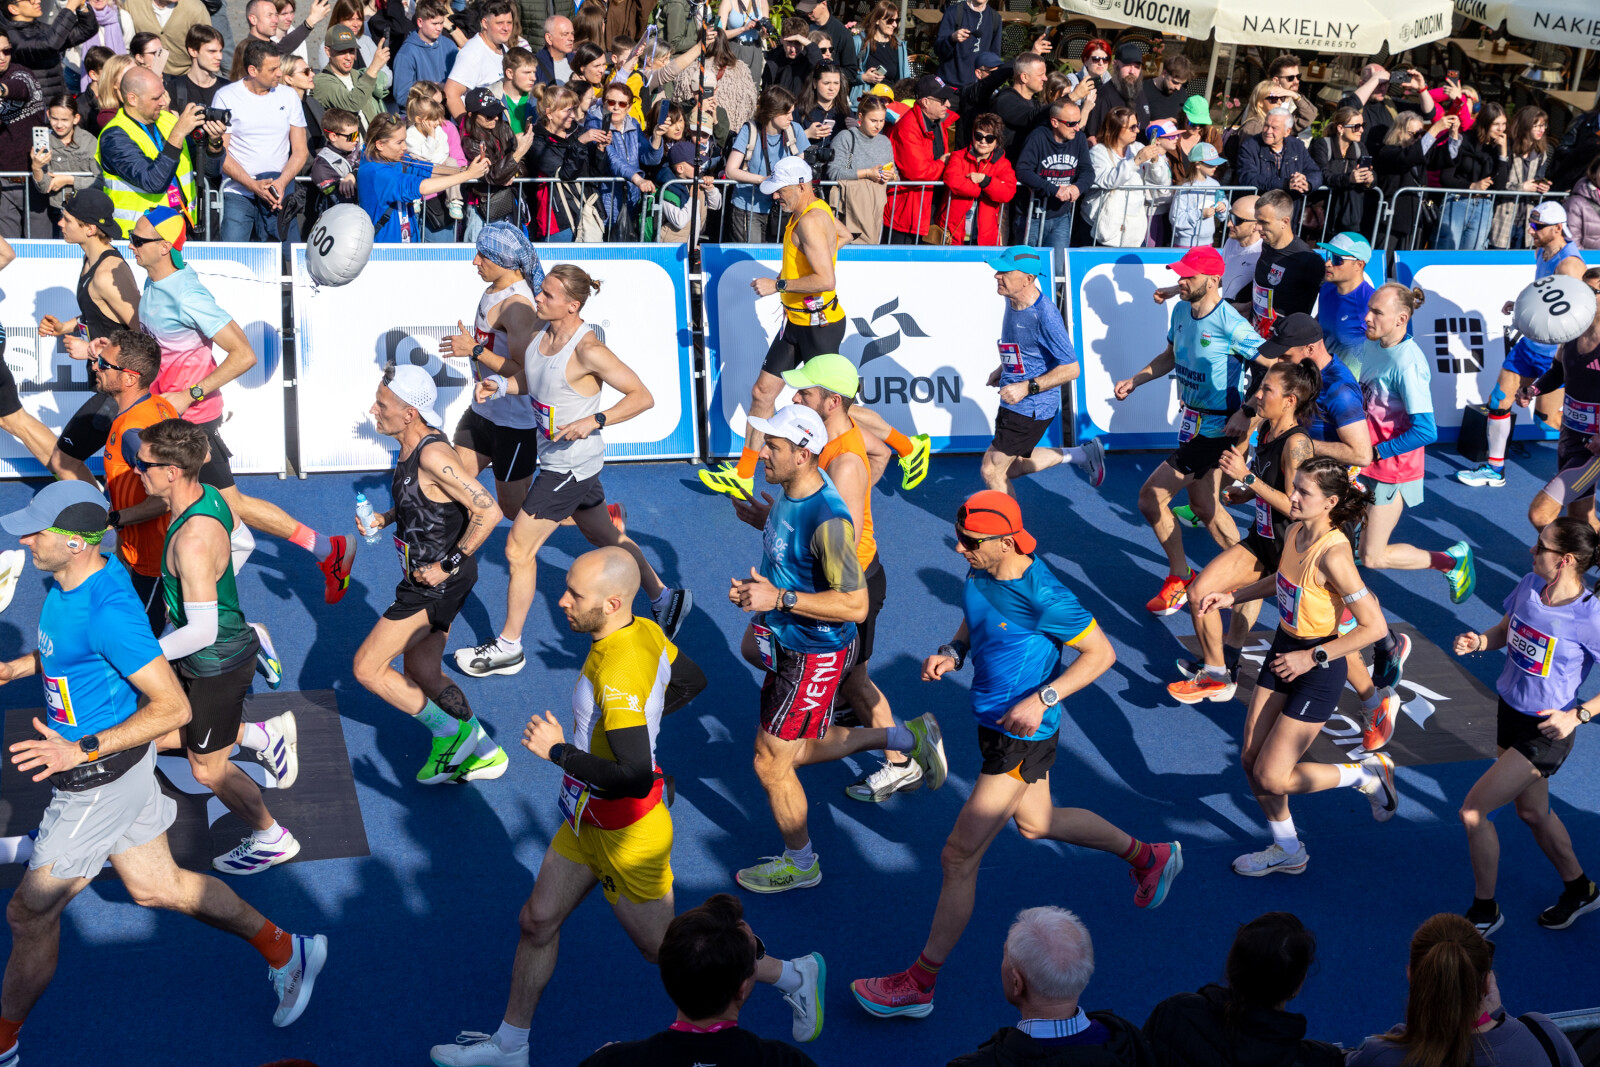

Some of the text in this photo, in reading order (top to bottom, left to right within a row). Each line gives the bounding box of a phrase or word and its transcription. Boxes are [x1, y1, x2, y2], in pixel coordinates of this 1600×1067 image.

[1123, 0, 1191, 29] OKOCIM
[1453, 0, 1487, 20] OCIM
[1242, 15, 1360, 40] NAKIELNY
[1413, 13, 1443, 39] OKOCIM
[1298, 38, 1357, 49] CAFE RESTO
[310, 215, 335, 257] :00
[1533, 276, 1571, 316] 3:00
[852, 375, 961, 405] URON
[1511, 633, 1537, 657] 280
[769, 874, 795, 887] HOKA
